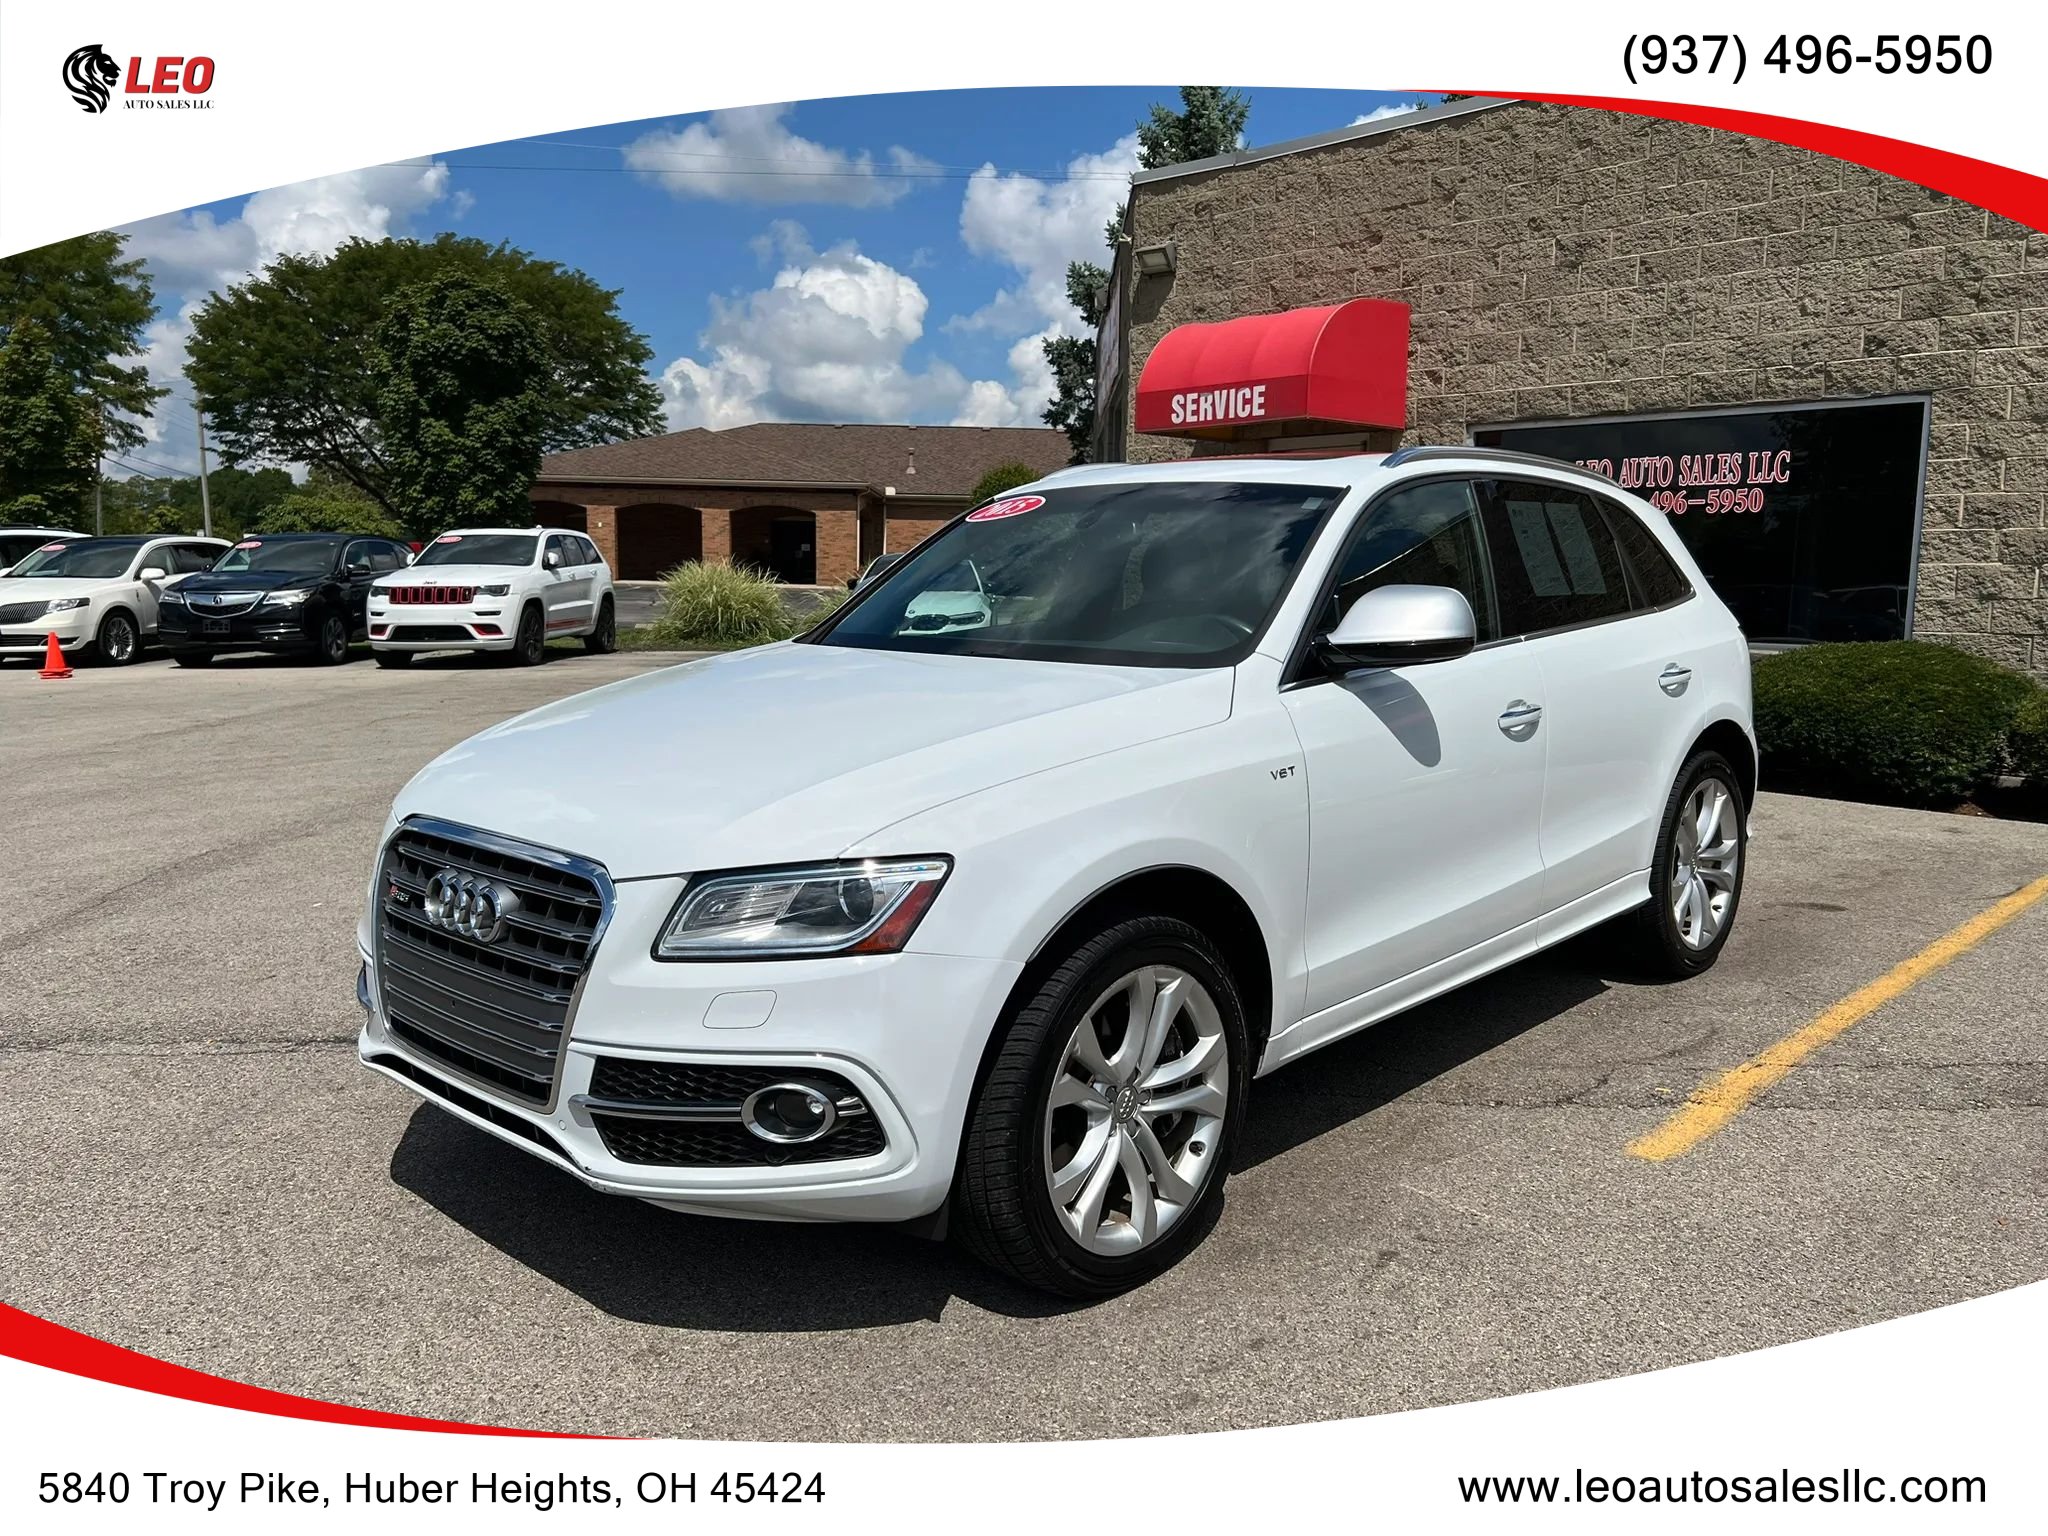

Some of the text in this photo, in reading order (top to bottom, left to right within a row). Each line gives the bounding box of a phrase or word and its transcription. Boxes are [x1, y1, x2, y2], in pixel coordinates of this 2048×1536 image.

[1170, 385, 1266, 425] SERVICE
[1618, 456, 1675, 488] AUTO
[1679, 453, 1742, 486] SALES
[1746, 450, 1791, 484] LLC
